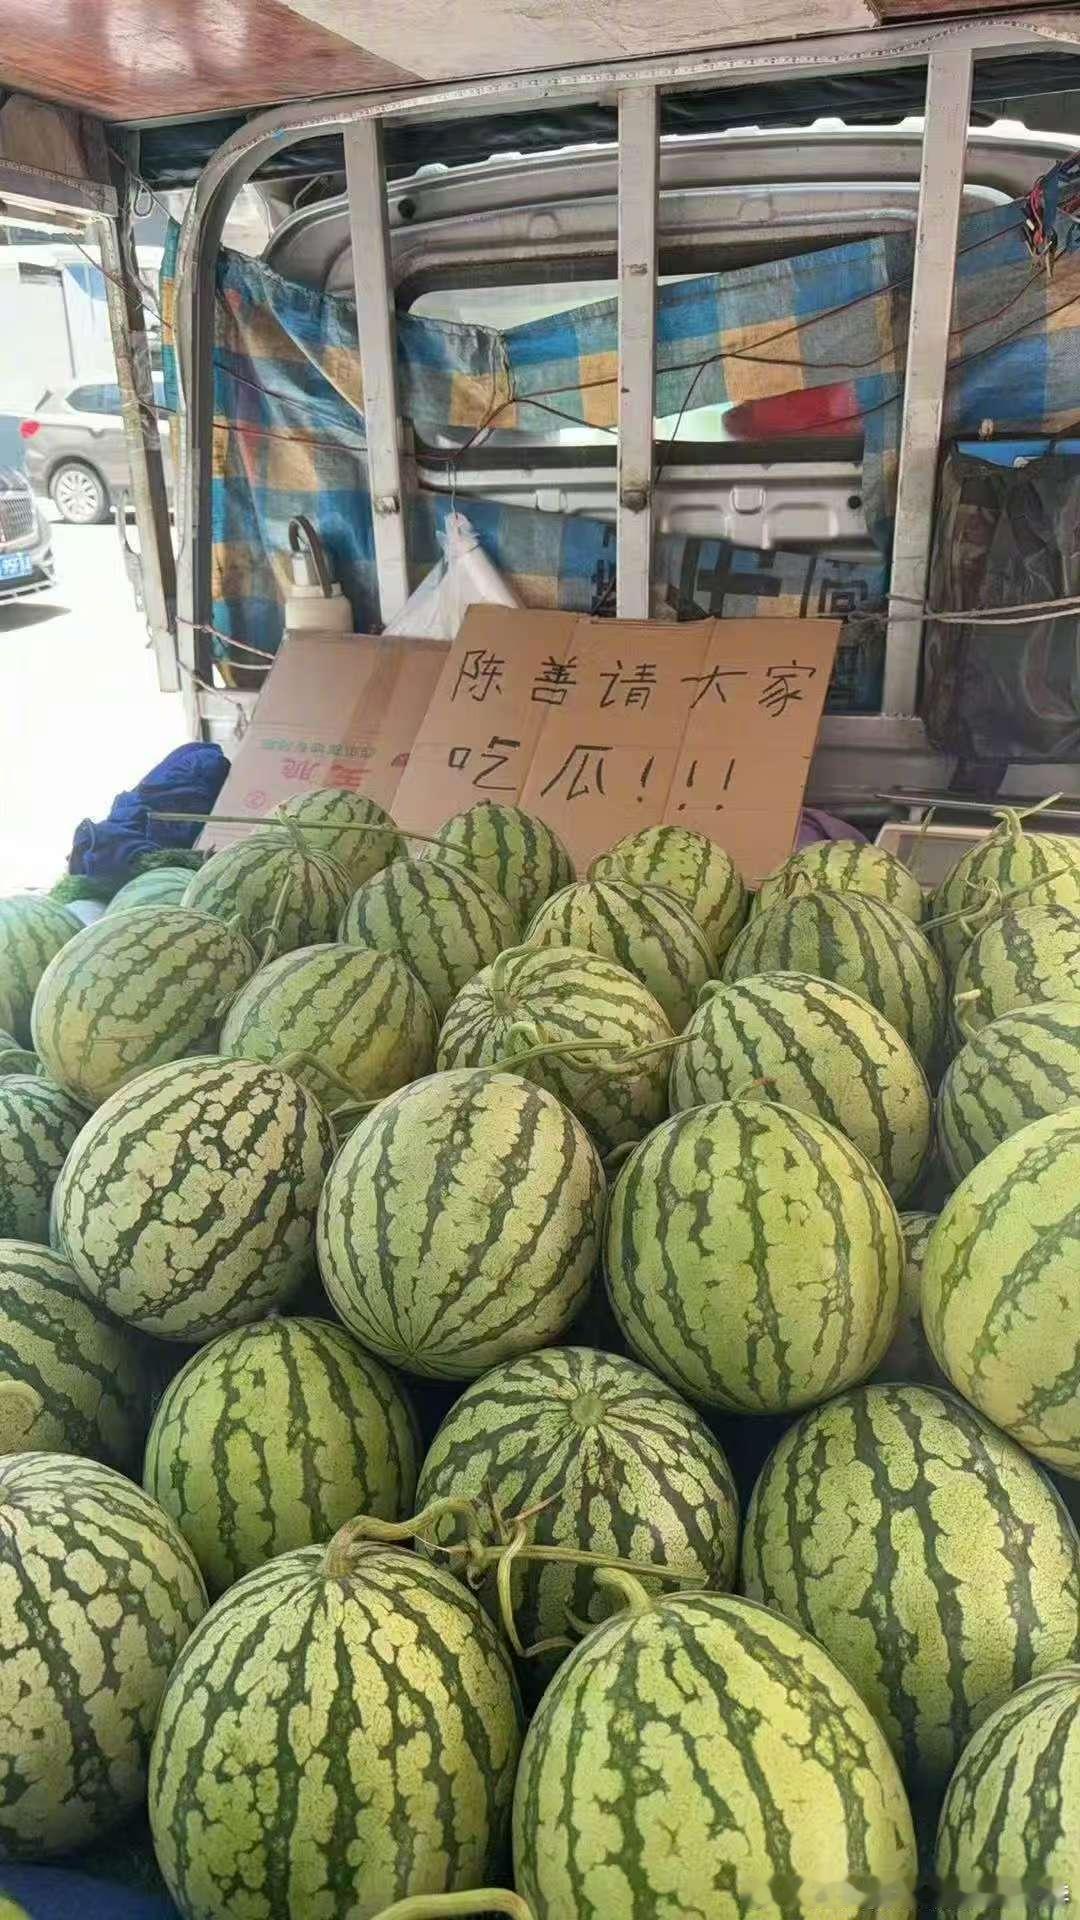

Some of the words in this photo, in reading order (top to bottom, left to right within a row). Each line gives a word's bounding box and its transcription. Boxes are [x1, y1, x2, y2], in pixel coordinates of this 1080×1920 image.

[451, 650, 818, 718] 陈善请大家
